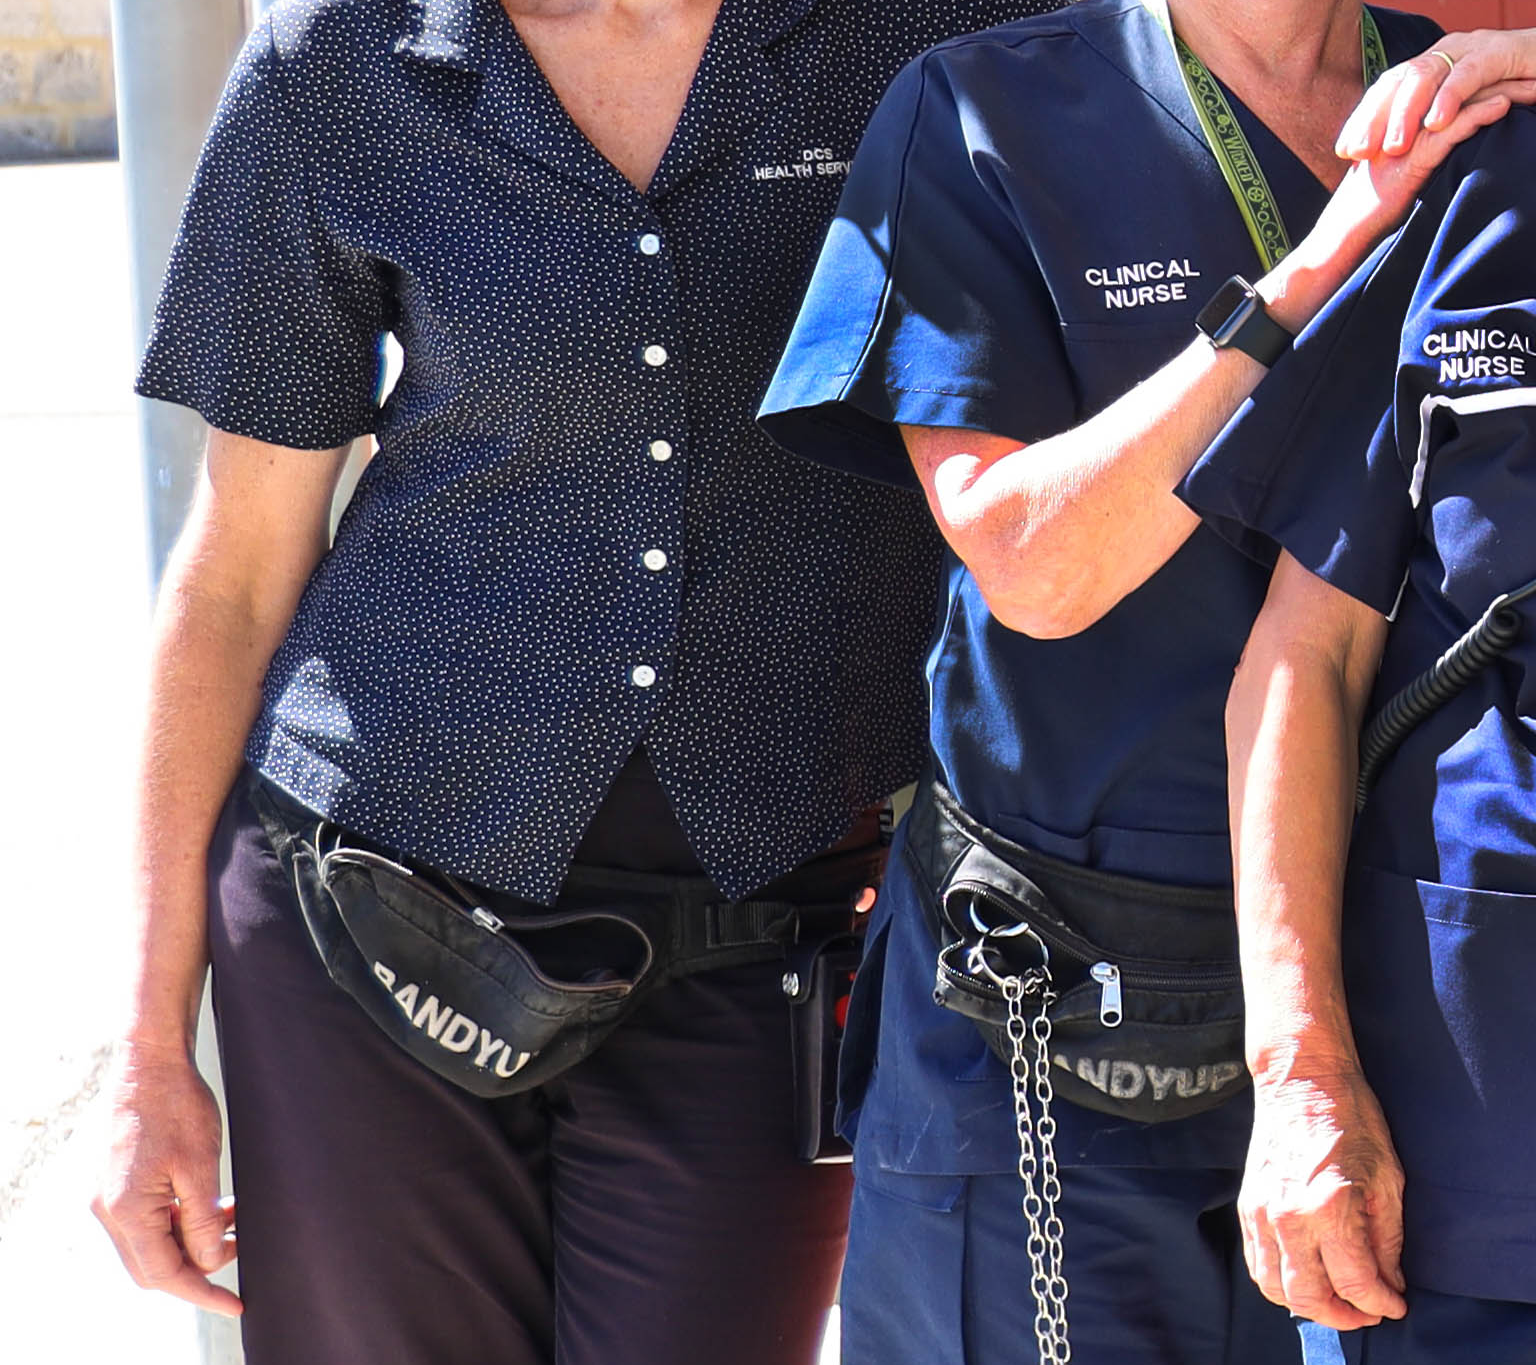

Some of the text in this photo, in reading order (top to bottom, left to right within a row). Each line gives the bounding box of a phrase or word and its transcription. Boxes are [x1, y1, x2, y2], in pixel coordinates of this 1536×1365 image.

[803, 147, 834, 162] DCS
[1222, 132, 1253, 183] WICKED
[754, 163, 812, 180] HEALTH
[1085, 259, 1200, 286] CLINICAL
[1104, 282, 1187, 309] NURSE
[1439, 355, 1526, 383] NURSE
[373, 961, 539, 1079] ANDYU
